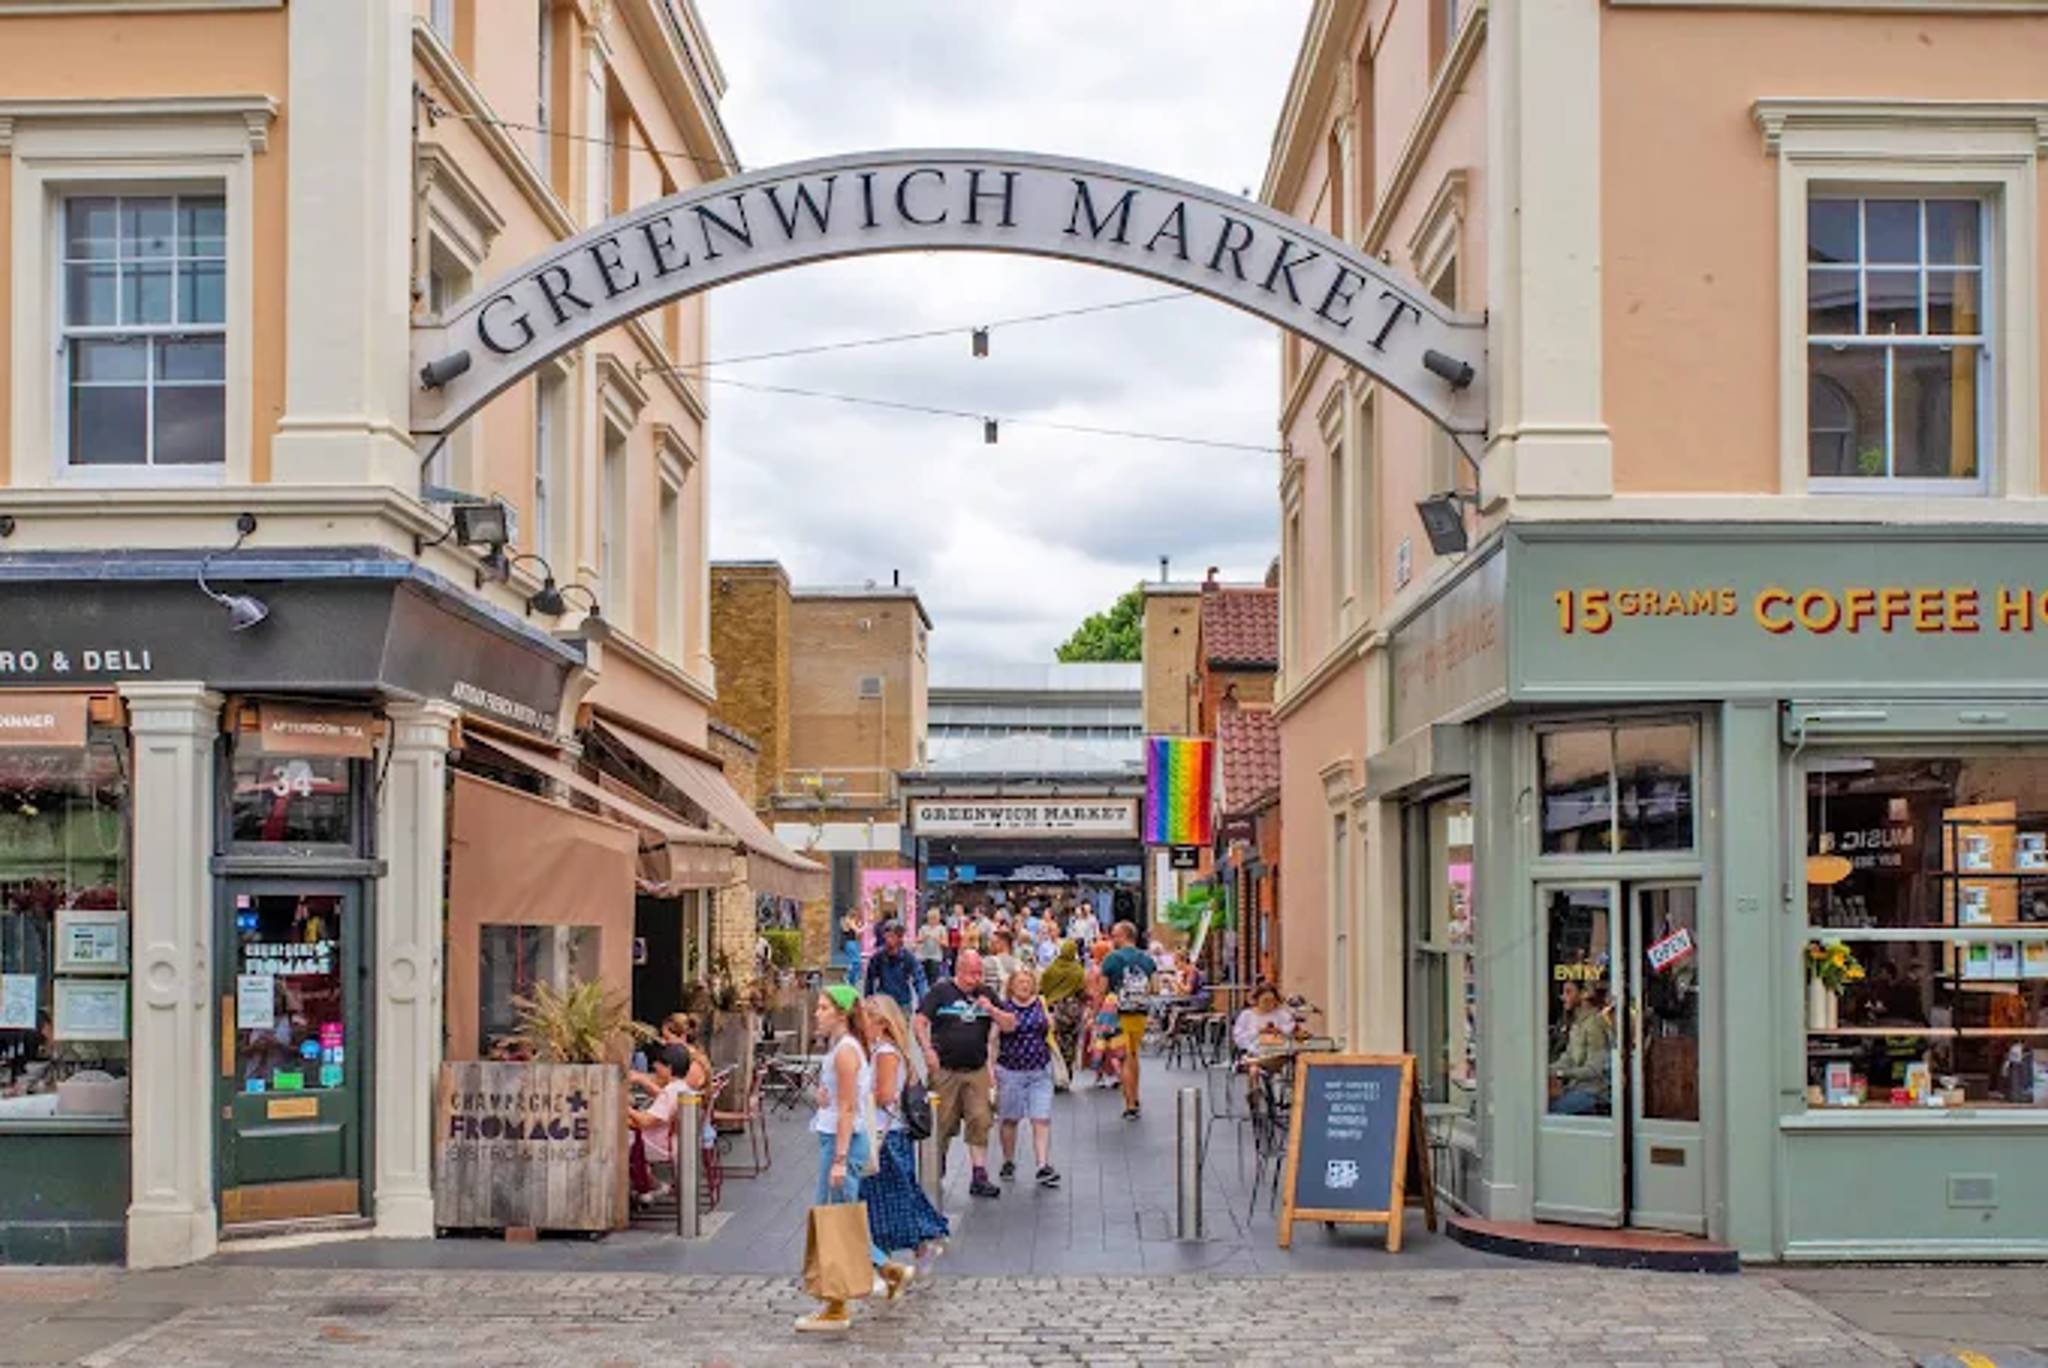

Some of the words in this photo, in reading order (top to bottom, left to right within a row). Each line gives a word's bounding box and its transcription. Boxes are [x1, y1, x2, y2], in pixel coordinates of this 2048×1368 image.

[478, 166, 1019, 354] GREENWICH
[1063, 170, 1421, 353] MARKET
[1753, 587, 1979, 634] COFFEE
[1996, 588, 2048, 633] H
[52, 651, 70, 672] &
[83, 651, 151, 671] DELI
[921, 808, 1037, 821] GREENWICH
[1044, 808, 1127, 820] MARKET
[1553, 964, 1604, 981] ENTRY
[450, 1115, 590, 1140] FROMAGE
